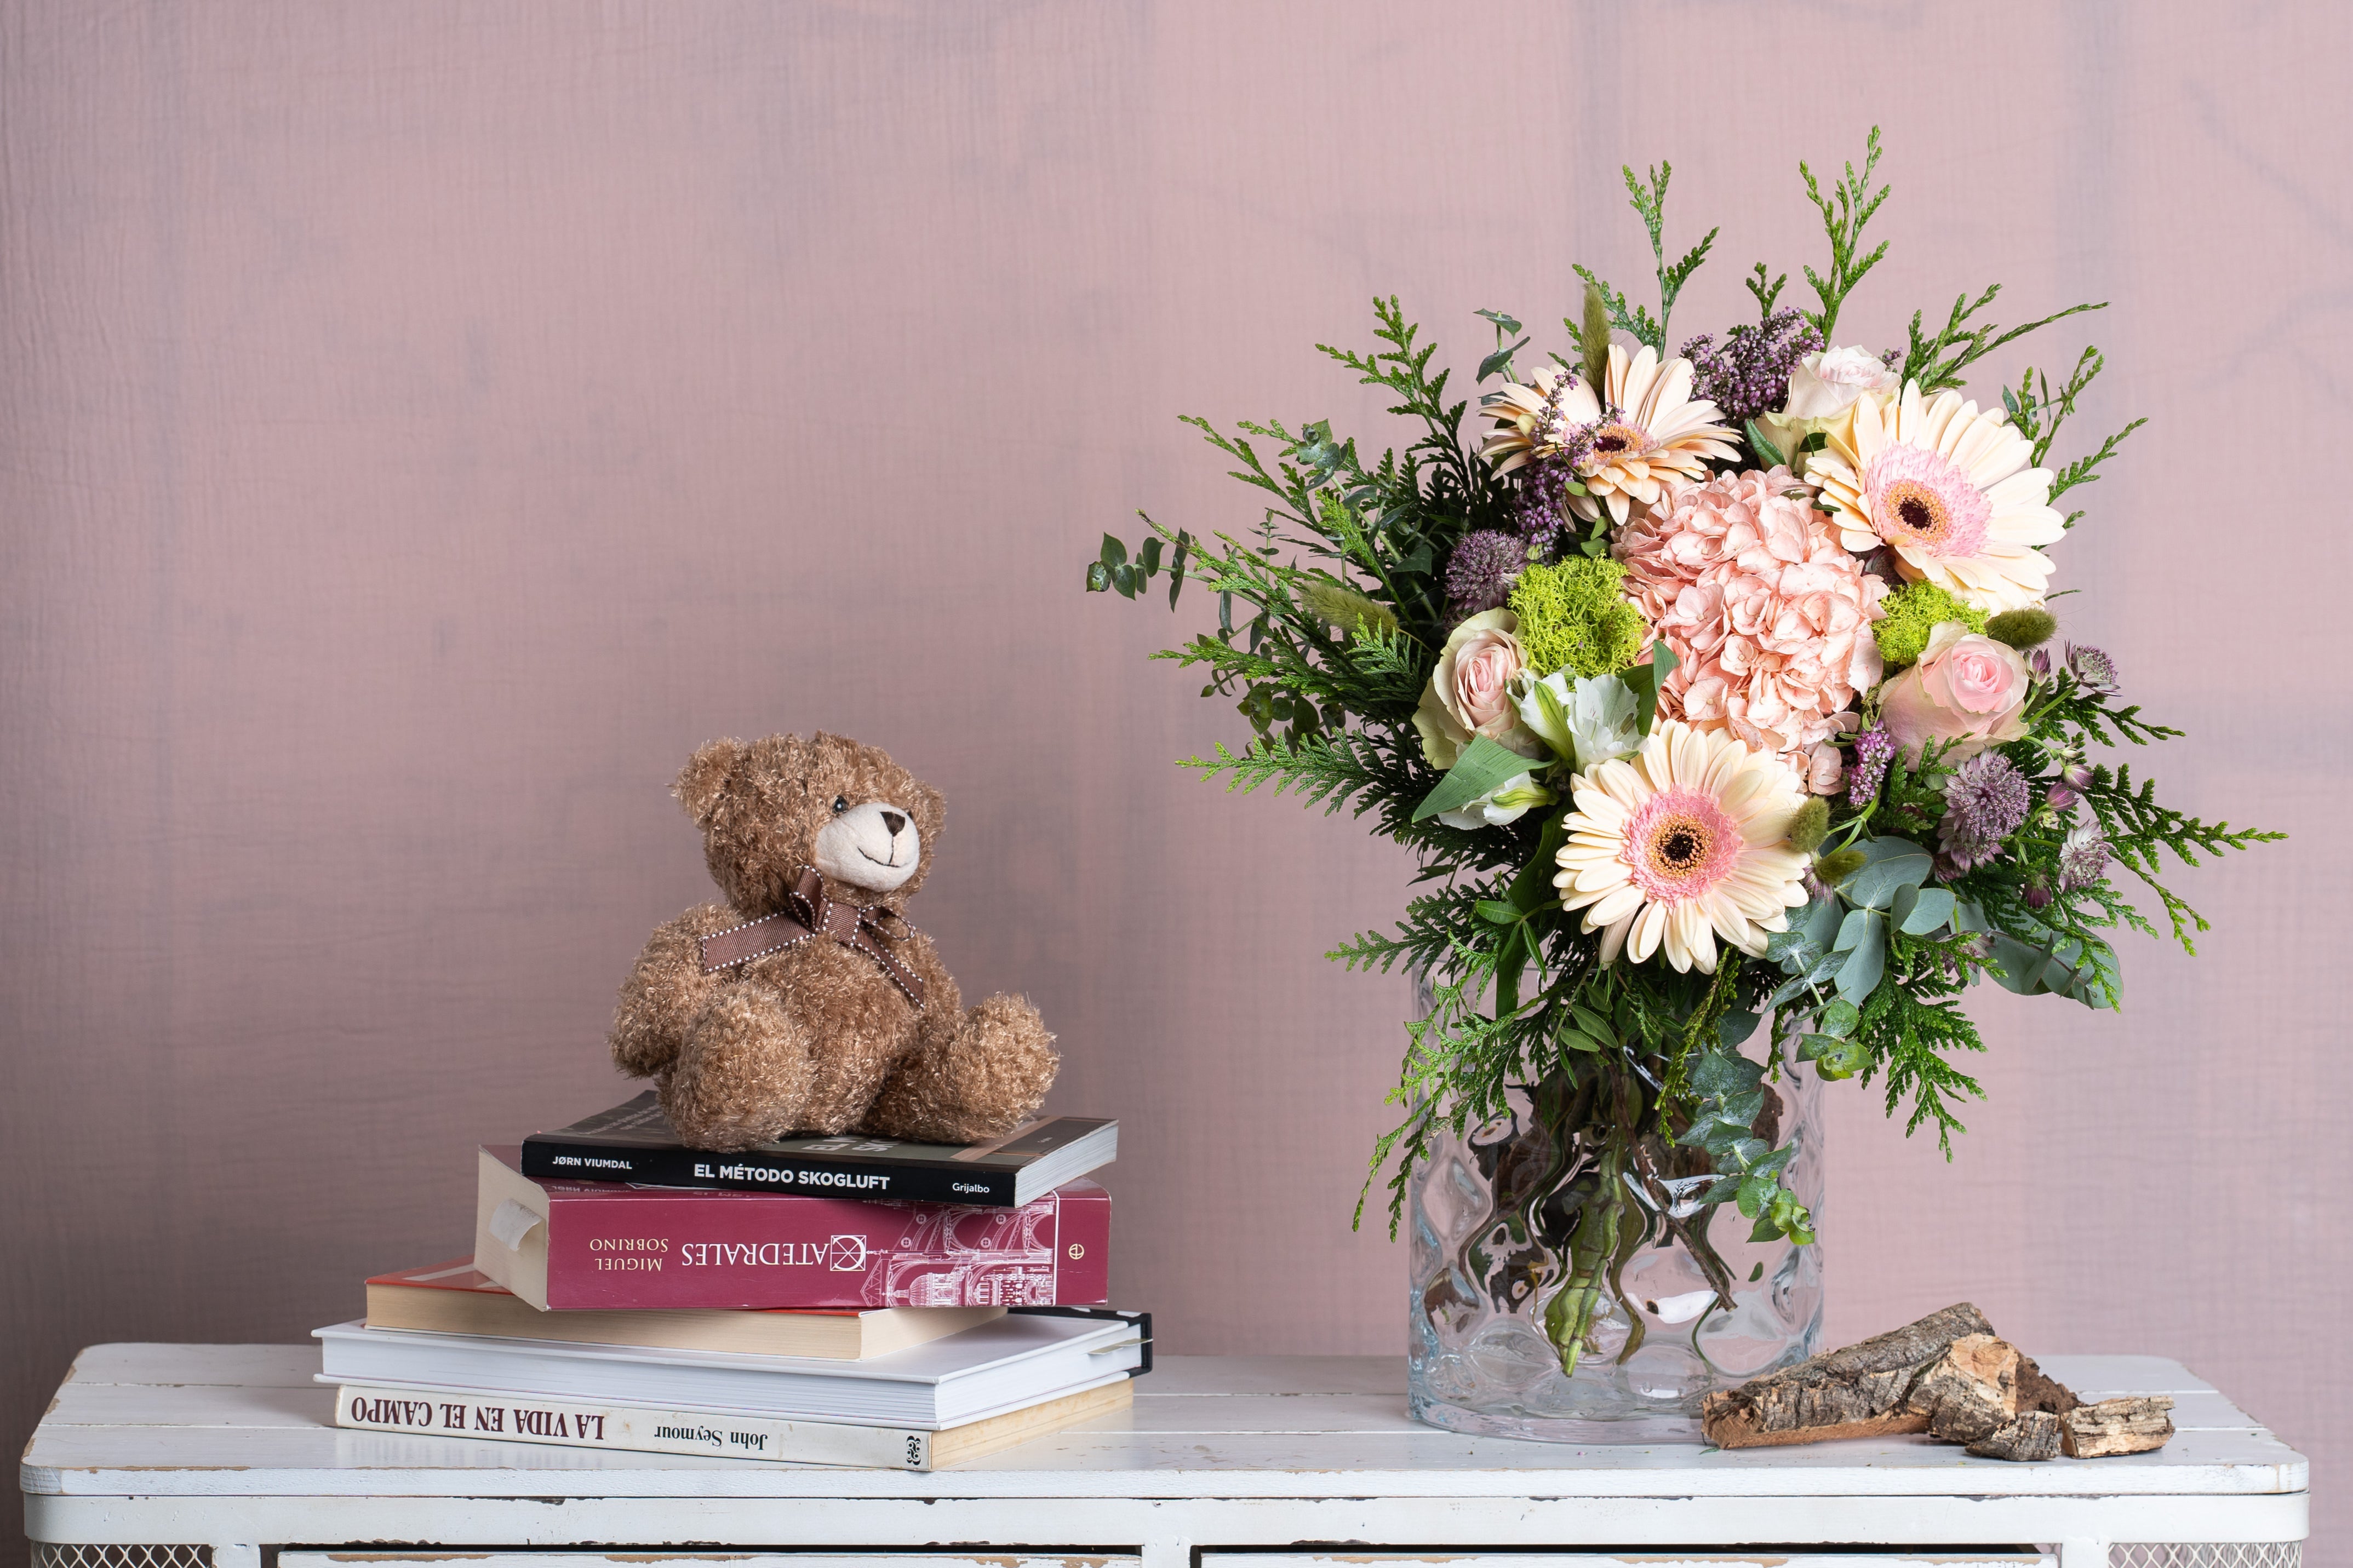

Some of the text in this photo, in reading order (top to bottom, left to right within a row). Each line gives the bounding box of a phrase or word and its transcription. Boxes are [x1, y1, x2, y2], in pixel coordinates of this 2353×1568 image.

[552, 1156, 633, 1169] JØRN VIUMDAL
[694, 1163, 890, 1190] EL MÉTODO SKOGLUFT
[952, 1182, 990, 1194] Grijalbo
[589, 1238, 669, 1253] SOBRINO
[682, 1236, 867, 1272] CATEDRALES
[594, 1258, 662, 1272] MIGUEL
[351, 1397, 605, 1440] LA VIDA EN EL CAMPO
[654, 1426, 768, 1450] John Seymour
